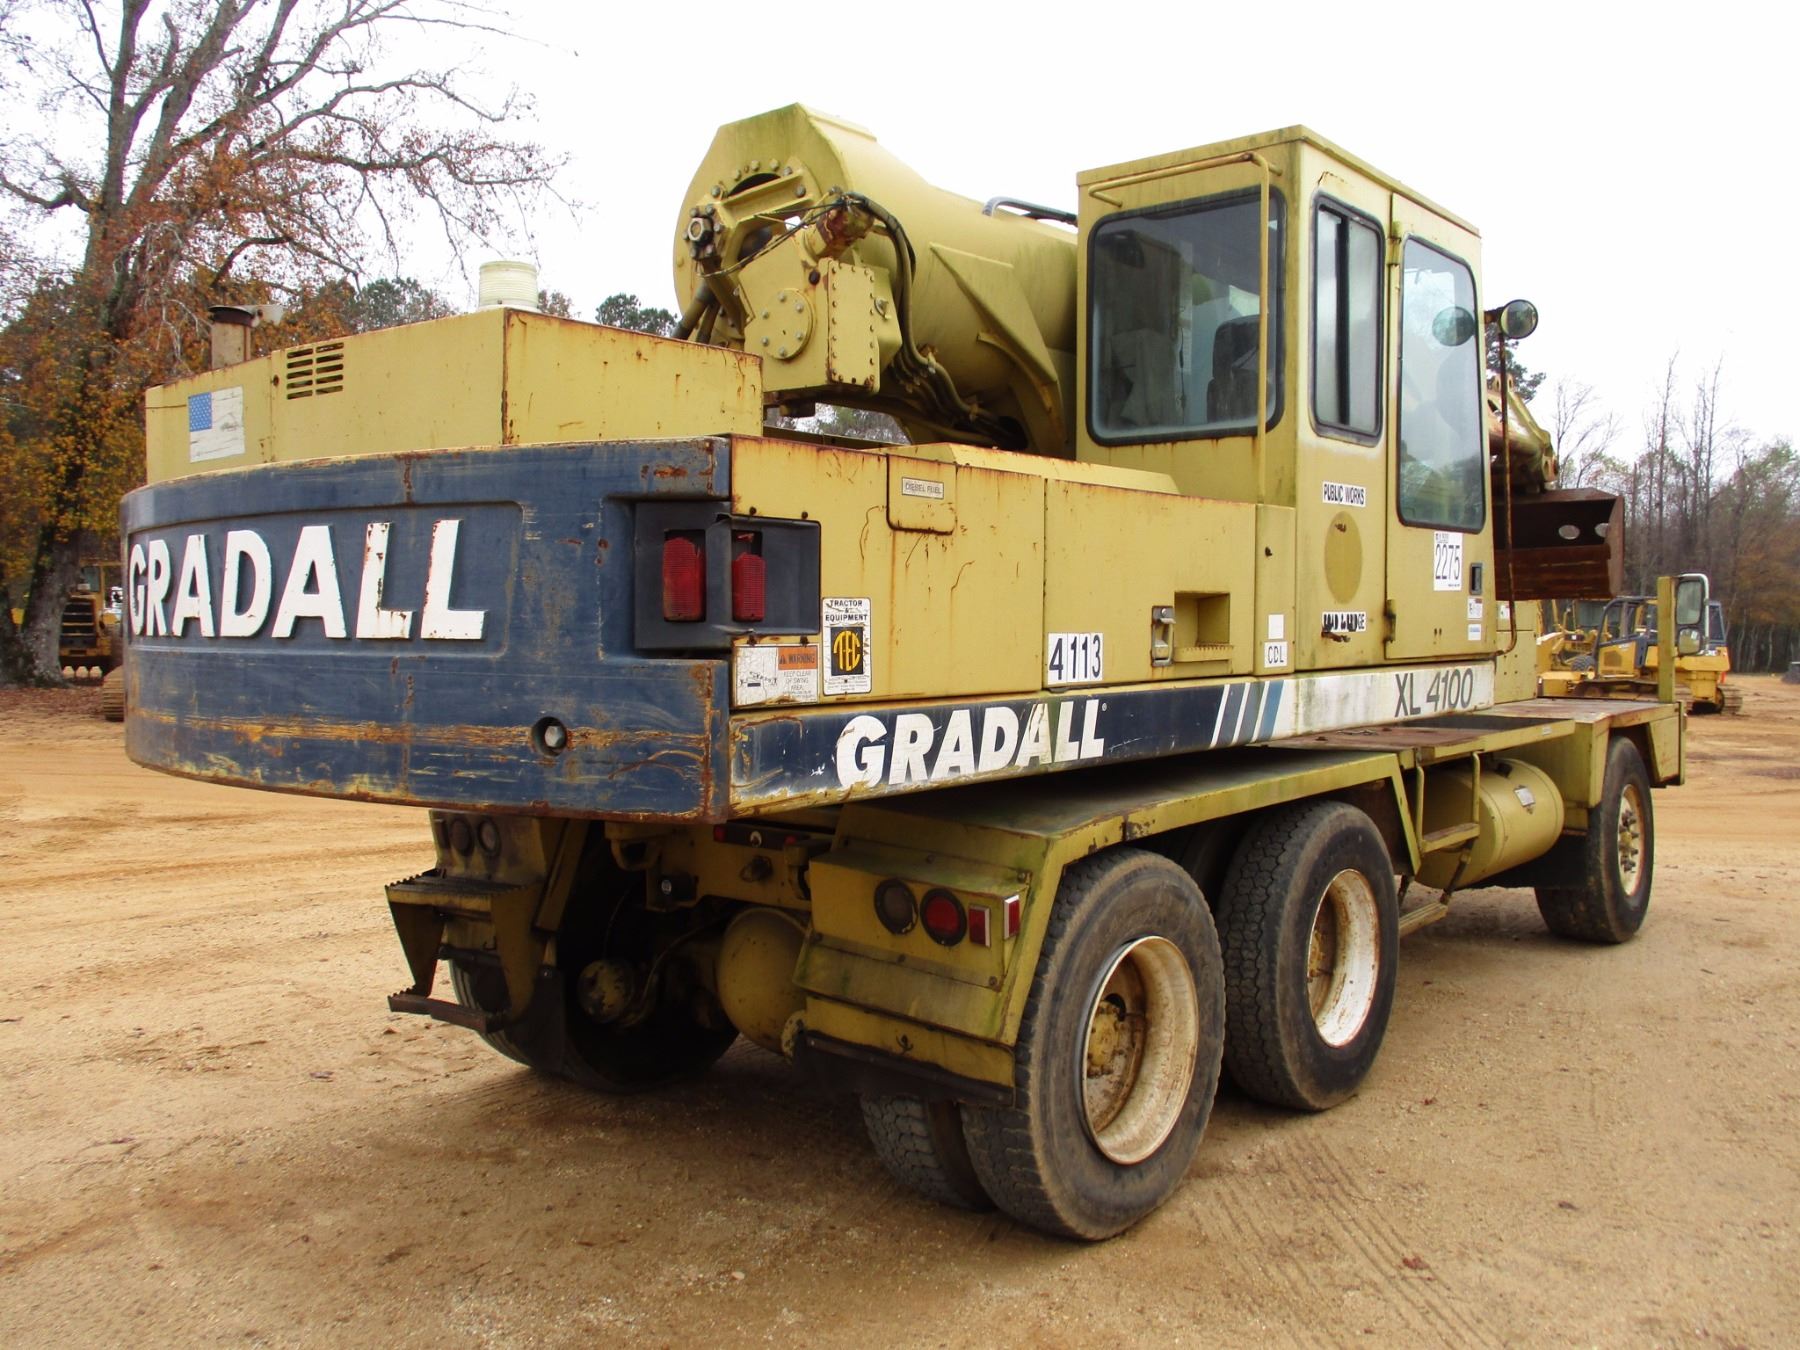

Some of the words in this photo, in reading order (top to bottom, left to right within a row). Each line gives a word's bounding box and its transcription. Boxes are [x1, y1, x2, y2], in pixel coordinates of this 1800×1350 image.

[1323, 483, 1344, 502] PUBLIC
[1344, 487, 1364, 505] WORKS
[129, 519, 486, 640] GRADALL
[1435, 543, 1460, 580] 2275
[825, 614, 868, 622] EQUIPMENT
[1049, 635, 1101, 681] 4113
[1268, 645, 1284, 664] CDL
[1394, 672, 1422, 718] XL
[1426, 668, 1474, 713] 4100
